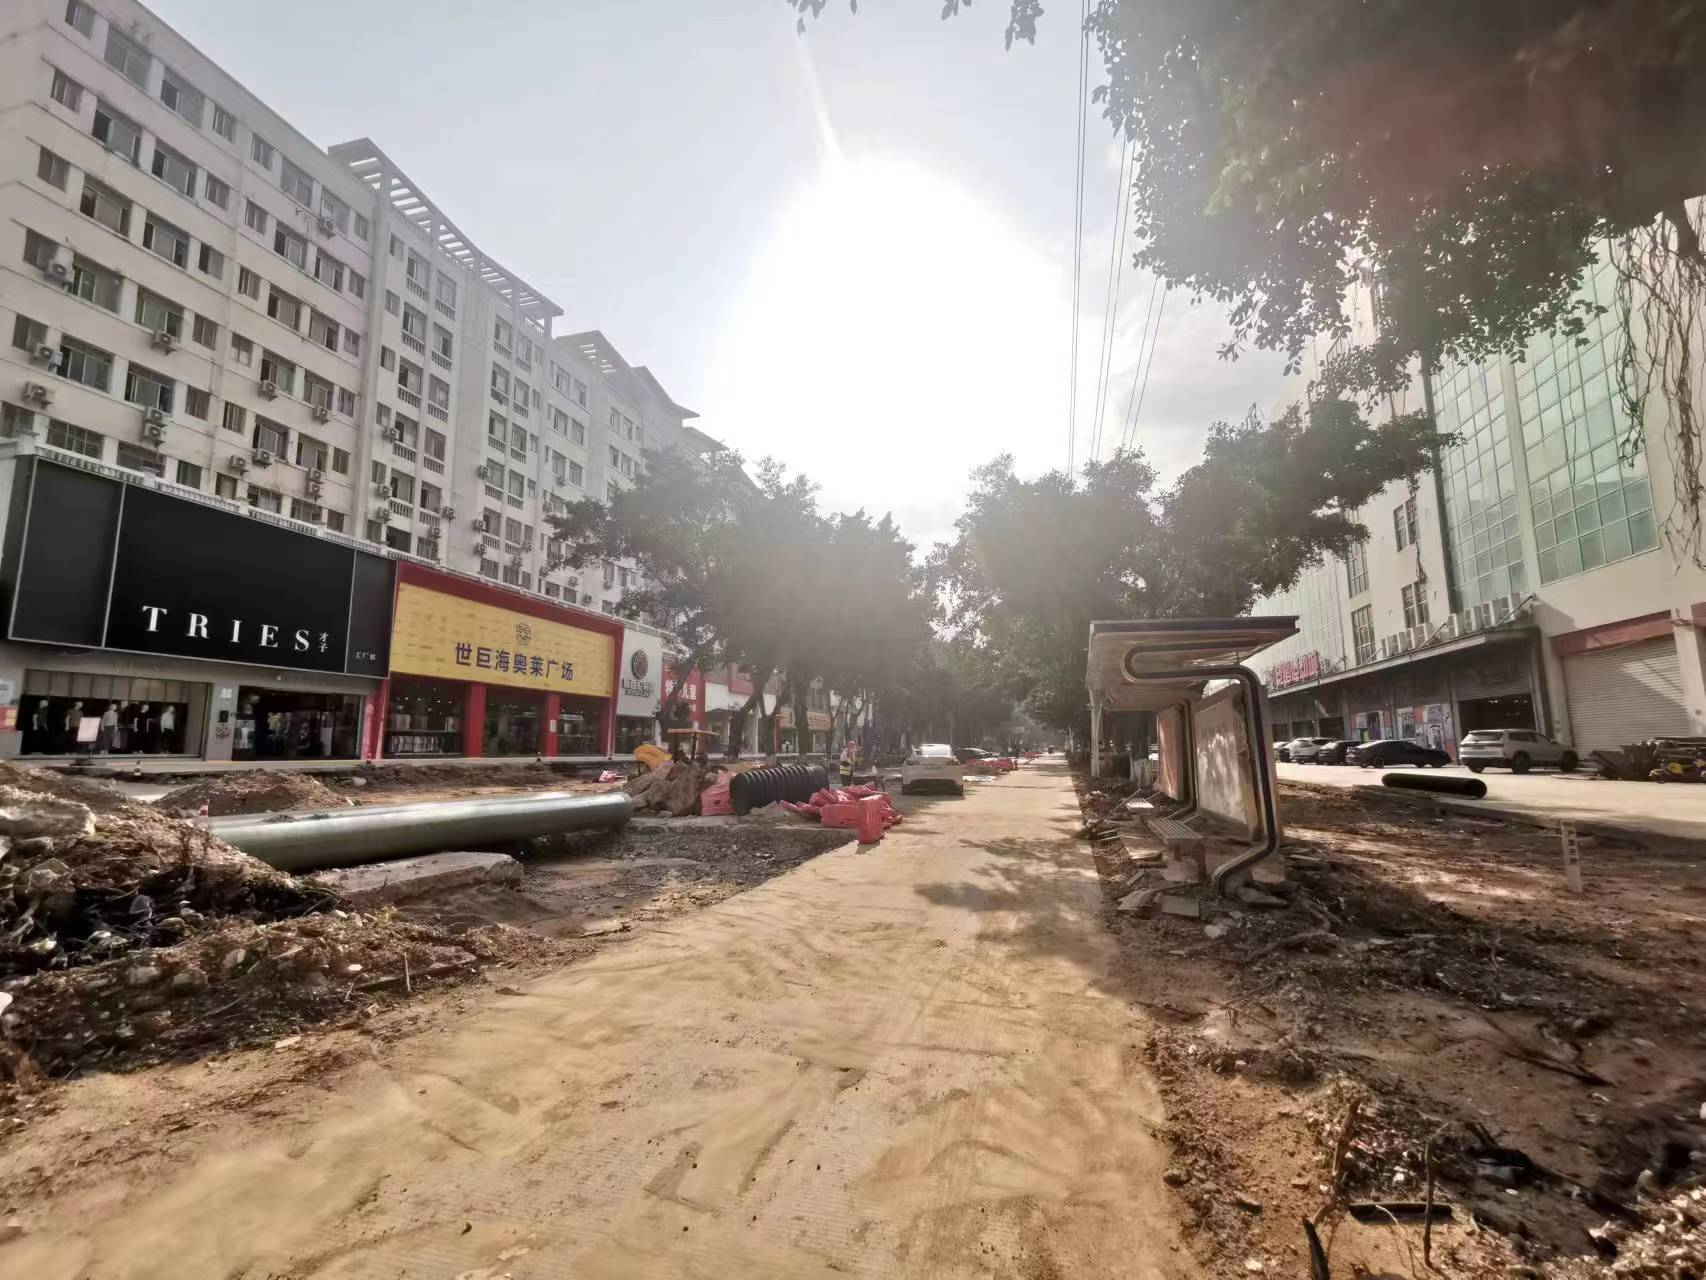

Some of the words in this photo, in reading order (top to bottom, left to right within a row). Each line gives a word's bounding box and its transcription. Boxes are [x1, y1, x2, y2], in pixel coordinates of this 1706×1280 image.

[142, 605, 310, 651] TRIES
[318, 631, 329, 653] 才子
[455, 642, 573, 681] 世巨海奥莱广场
